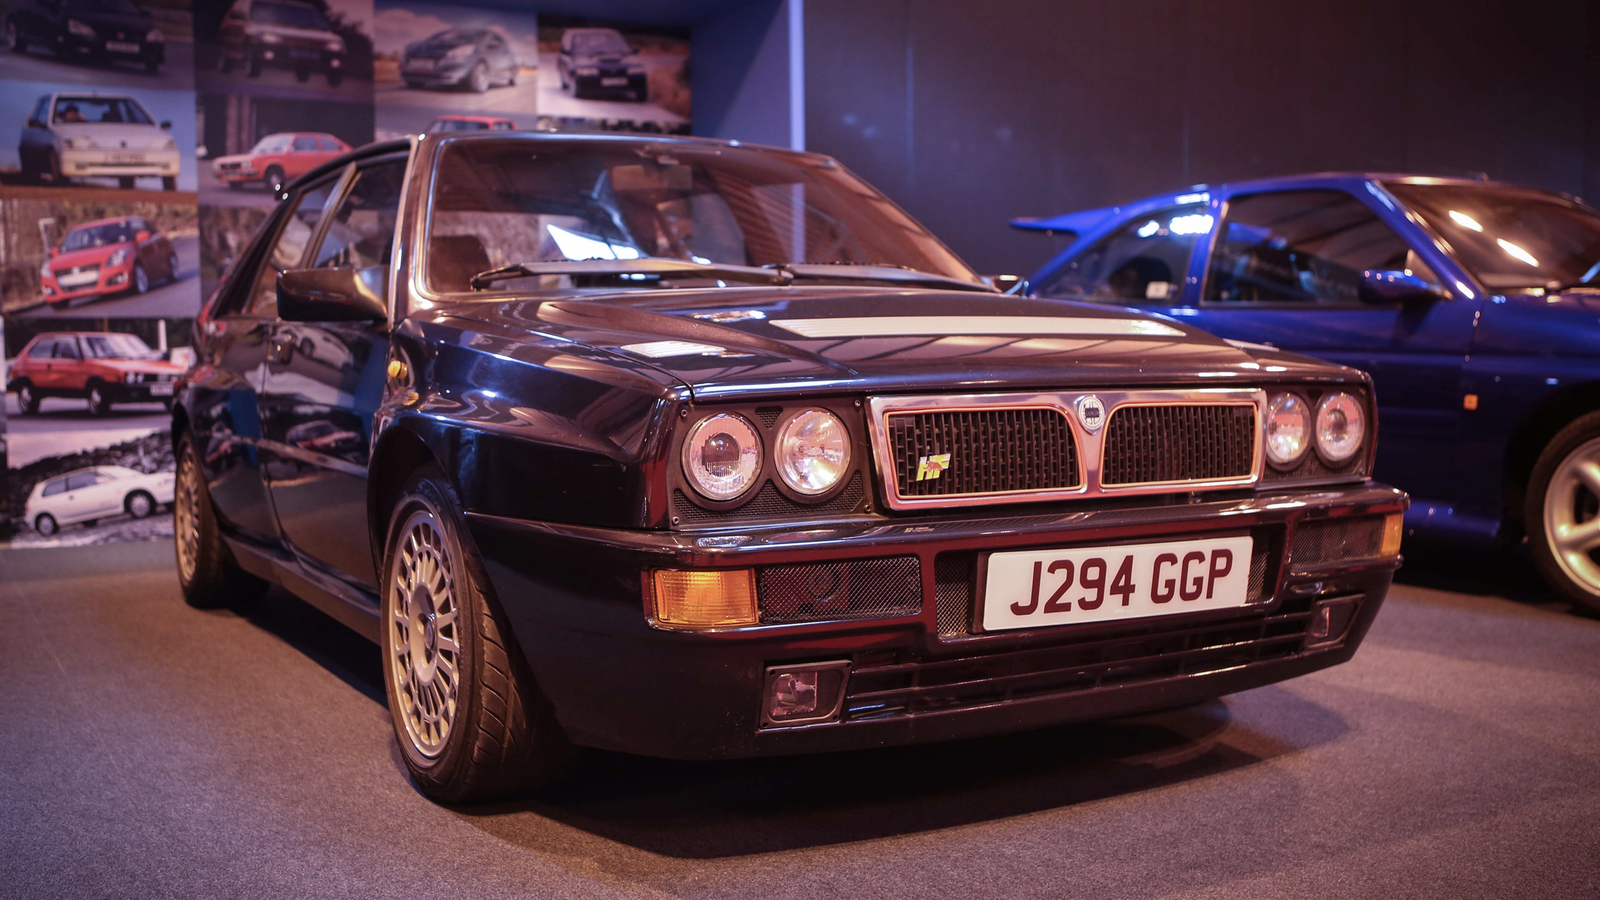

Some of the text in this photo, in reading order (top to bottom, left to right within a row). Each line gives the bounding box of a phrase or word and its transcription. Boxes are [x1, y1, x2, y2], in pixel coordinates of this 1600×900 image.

[916, 453, 951, 482] HF
[1009, 548, 1233, 616] J294 GGP
